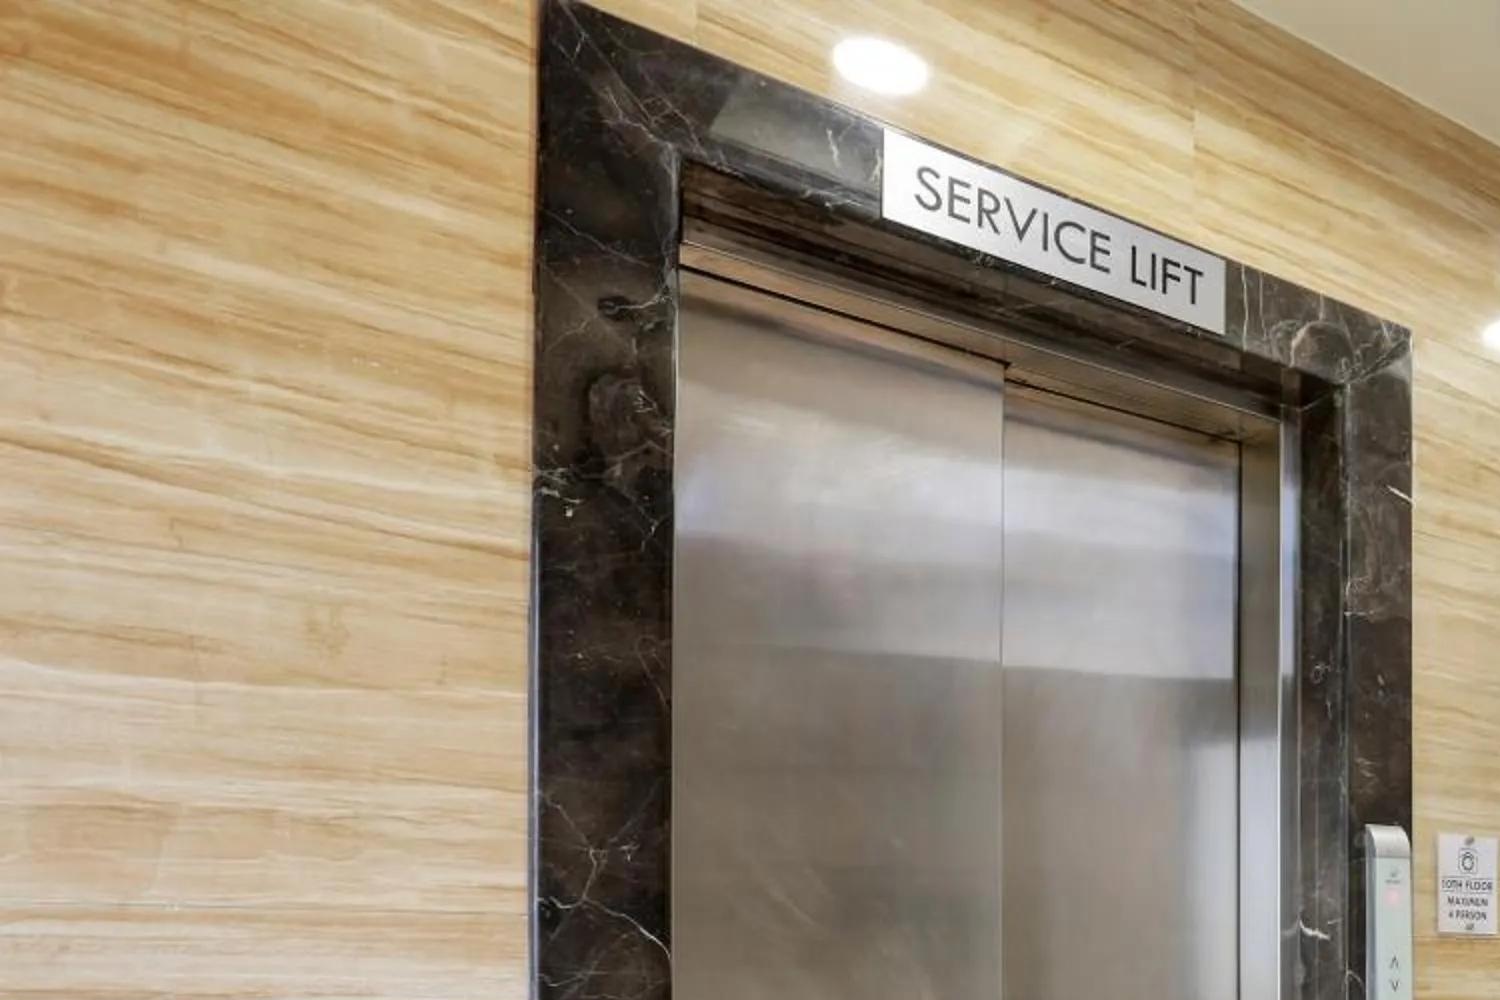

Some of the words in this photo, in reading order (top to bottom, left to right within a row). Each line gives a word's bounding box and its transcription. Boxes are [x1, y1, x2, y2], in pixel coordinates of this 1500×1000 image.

[914, 166, 1111, 274] SERVICE
[1130, 245, 1204, 305] LIFT
[1465, 880, 1493, 892] FLOOR
[1456, 909, 1487, 921] PERSON
